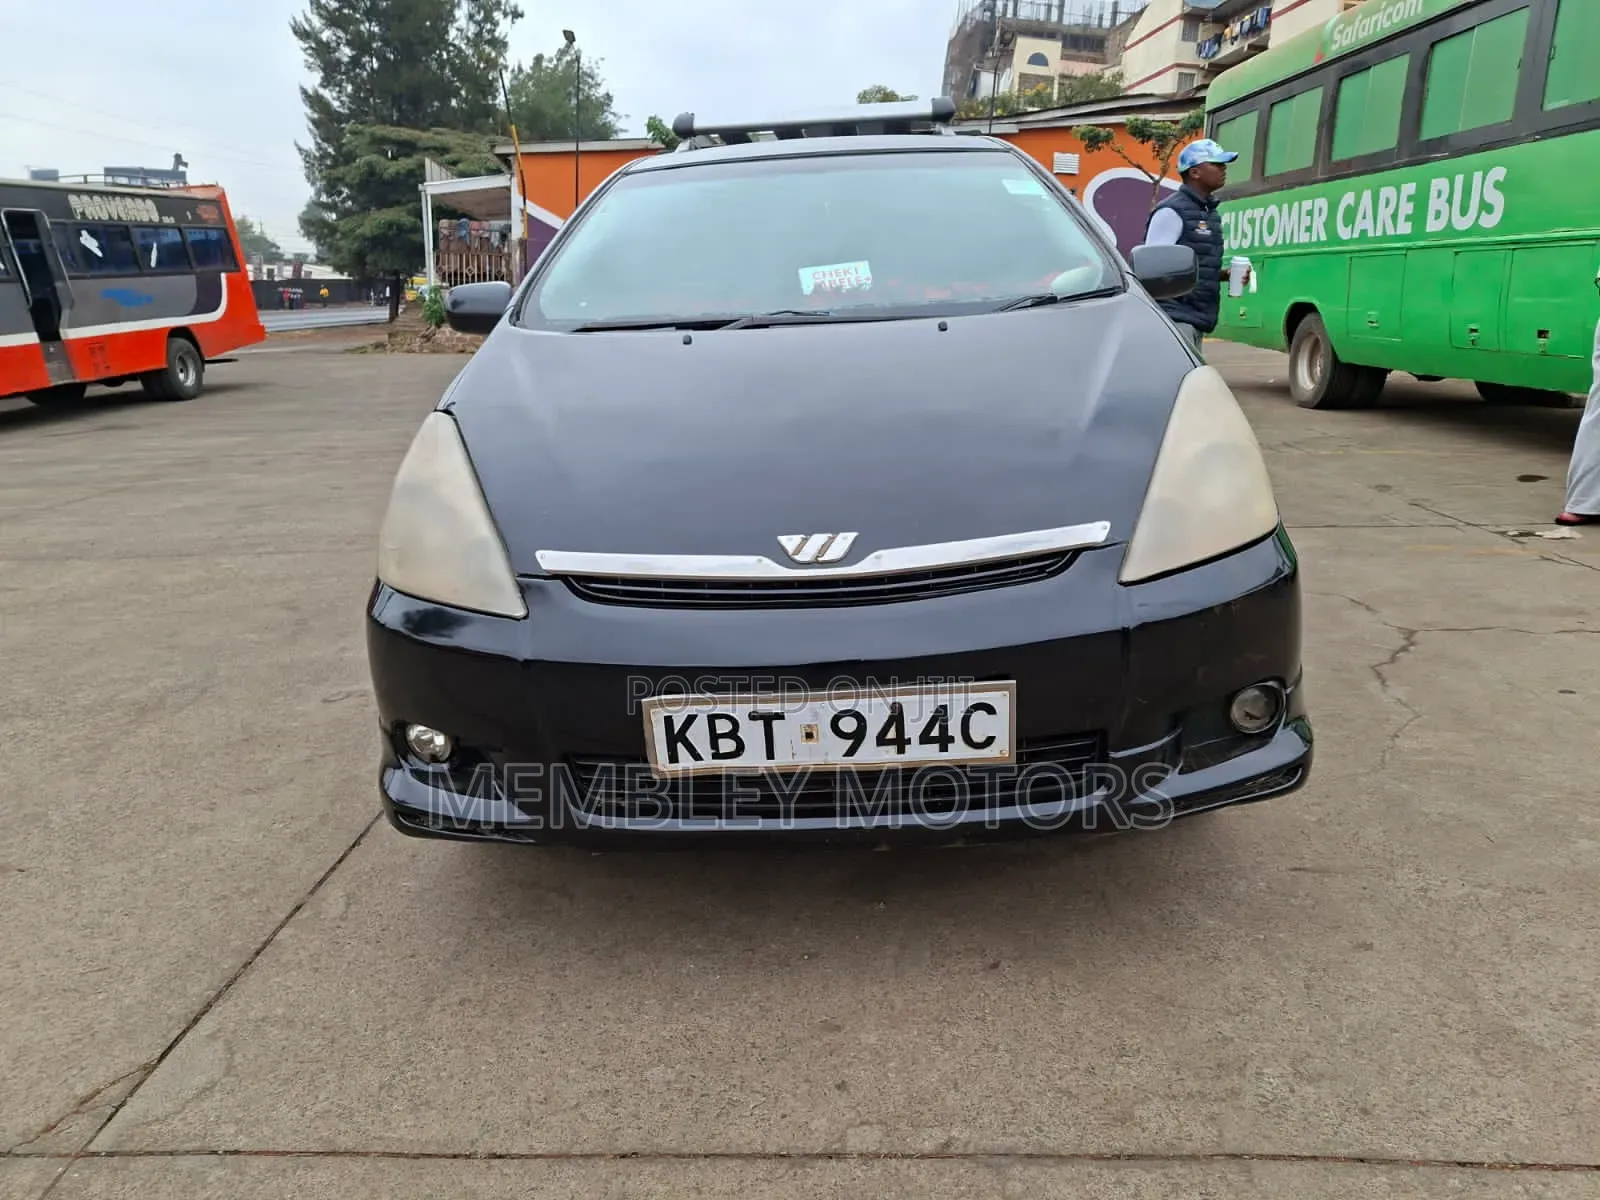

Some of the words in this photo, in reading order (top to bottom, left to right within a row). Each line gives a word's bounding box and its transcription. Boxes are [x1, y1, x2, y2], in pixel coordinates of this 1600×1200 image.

[1331, 0, 1422, 50] Safaricom
[1222, 198, 1328, 249] CUSTOMER
[1337, 183, 1416, 240] CARE
[1426, 167, 1507, 232] BUS
[663, 711, 786, 764] KBT
[830, 702, 998, 758] 944C
